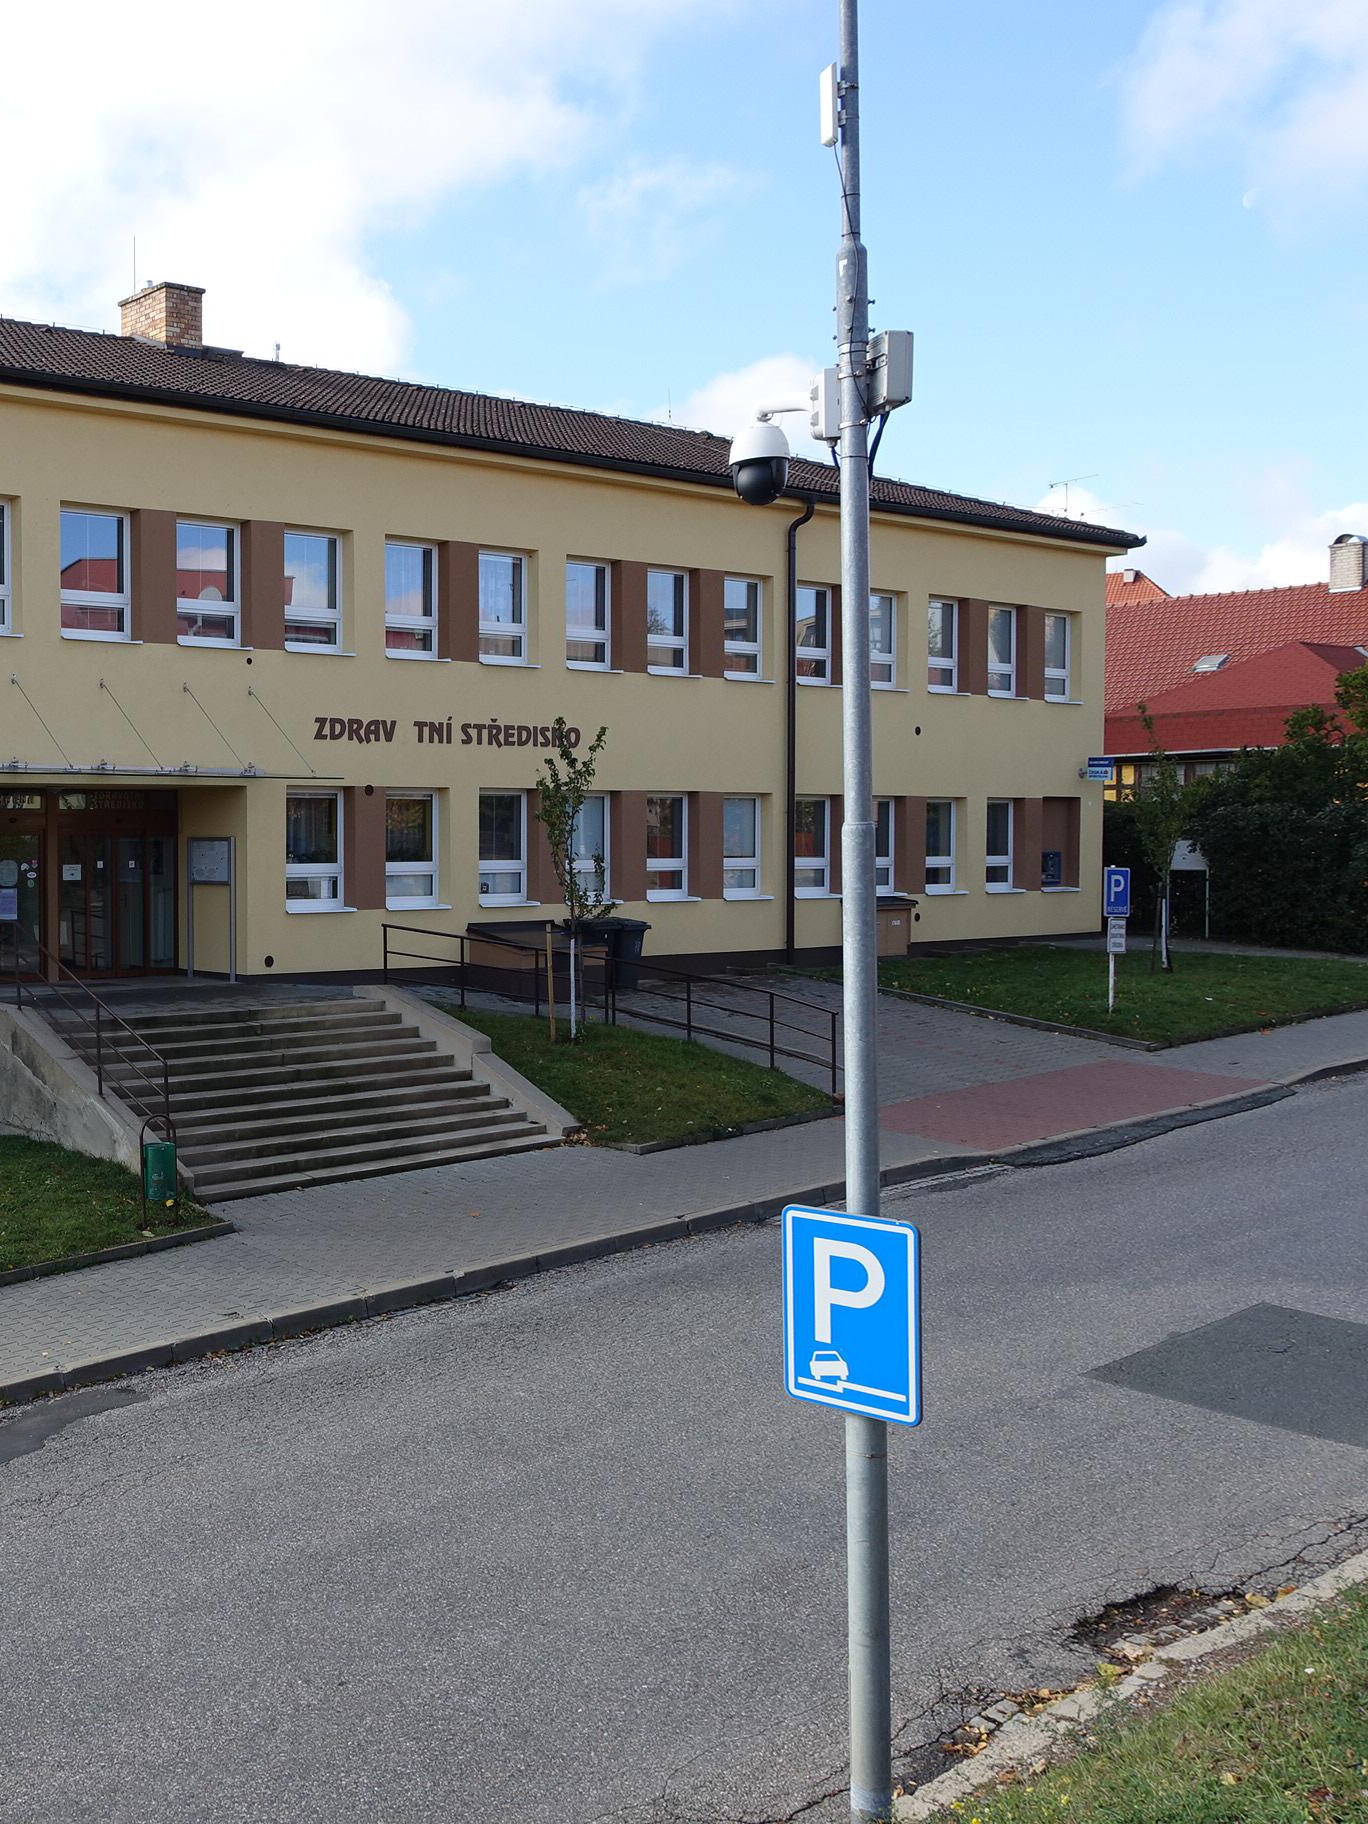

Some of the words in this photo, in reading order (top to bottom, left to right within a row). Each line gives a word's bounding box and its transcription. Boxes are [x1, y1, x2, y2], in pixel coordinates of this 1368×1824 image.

[313, 717, 397, 745] ZDRAV
[413, 716, 453, 745] TNÍ
[1109, 874, 1125, 902] P
[813, 1236, 886, 1344] P
